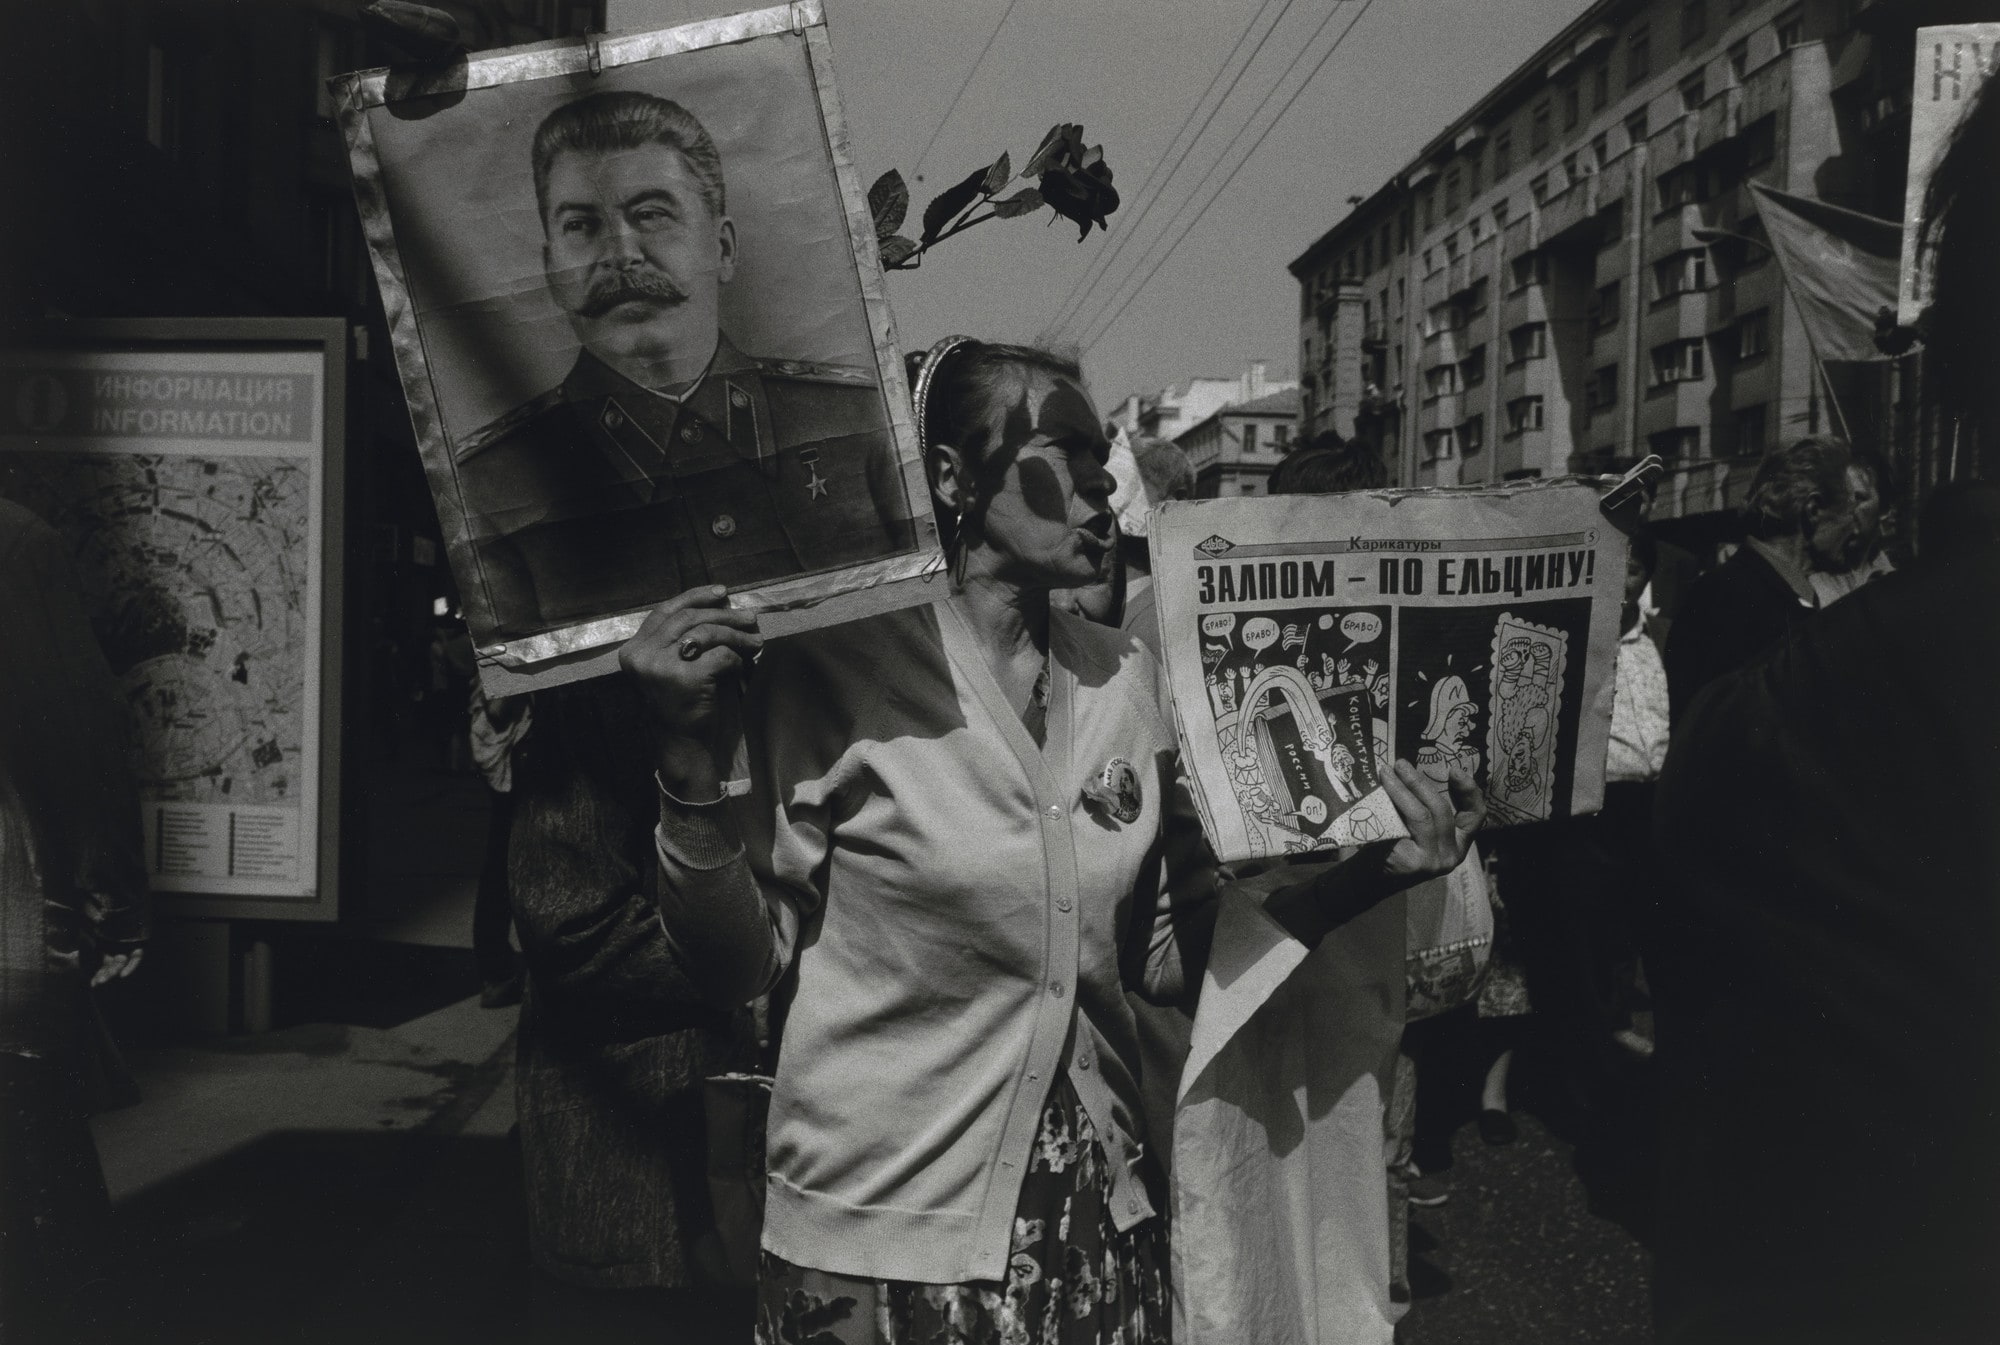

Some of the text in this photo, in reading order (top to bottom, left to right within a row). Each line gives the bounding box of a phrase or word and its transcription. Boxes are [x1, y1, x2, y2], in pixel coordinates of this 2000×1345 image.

[93, 376, 294, 405] ИНФОРМАЦИЯ
[93, 408, 293, 435] INFORMATION
[1349, 536, 1442, 552] Карикатуры
[1198, 560, 1335, 605] ЗАЛПОМ
[1379, 557, 1424, 596] ПО
[1438, 550, 1596, 598] ЕЛЬЦИНУ!
[1205, 616, 1232, 632] БРАВО!
[1245, 624, 1277, 642] БРАВО!
[1342, 619, 1380, 634] БРАВО!
[1348, 694, 1378, 789] КОНСТИТУЦИЯ
[1284, 742, 1311, 790] РОССИИ
